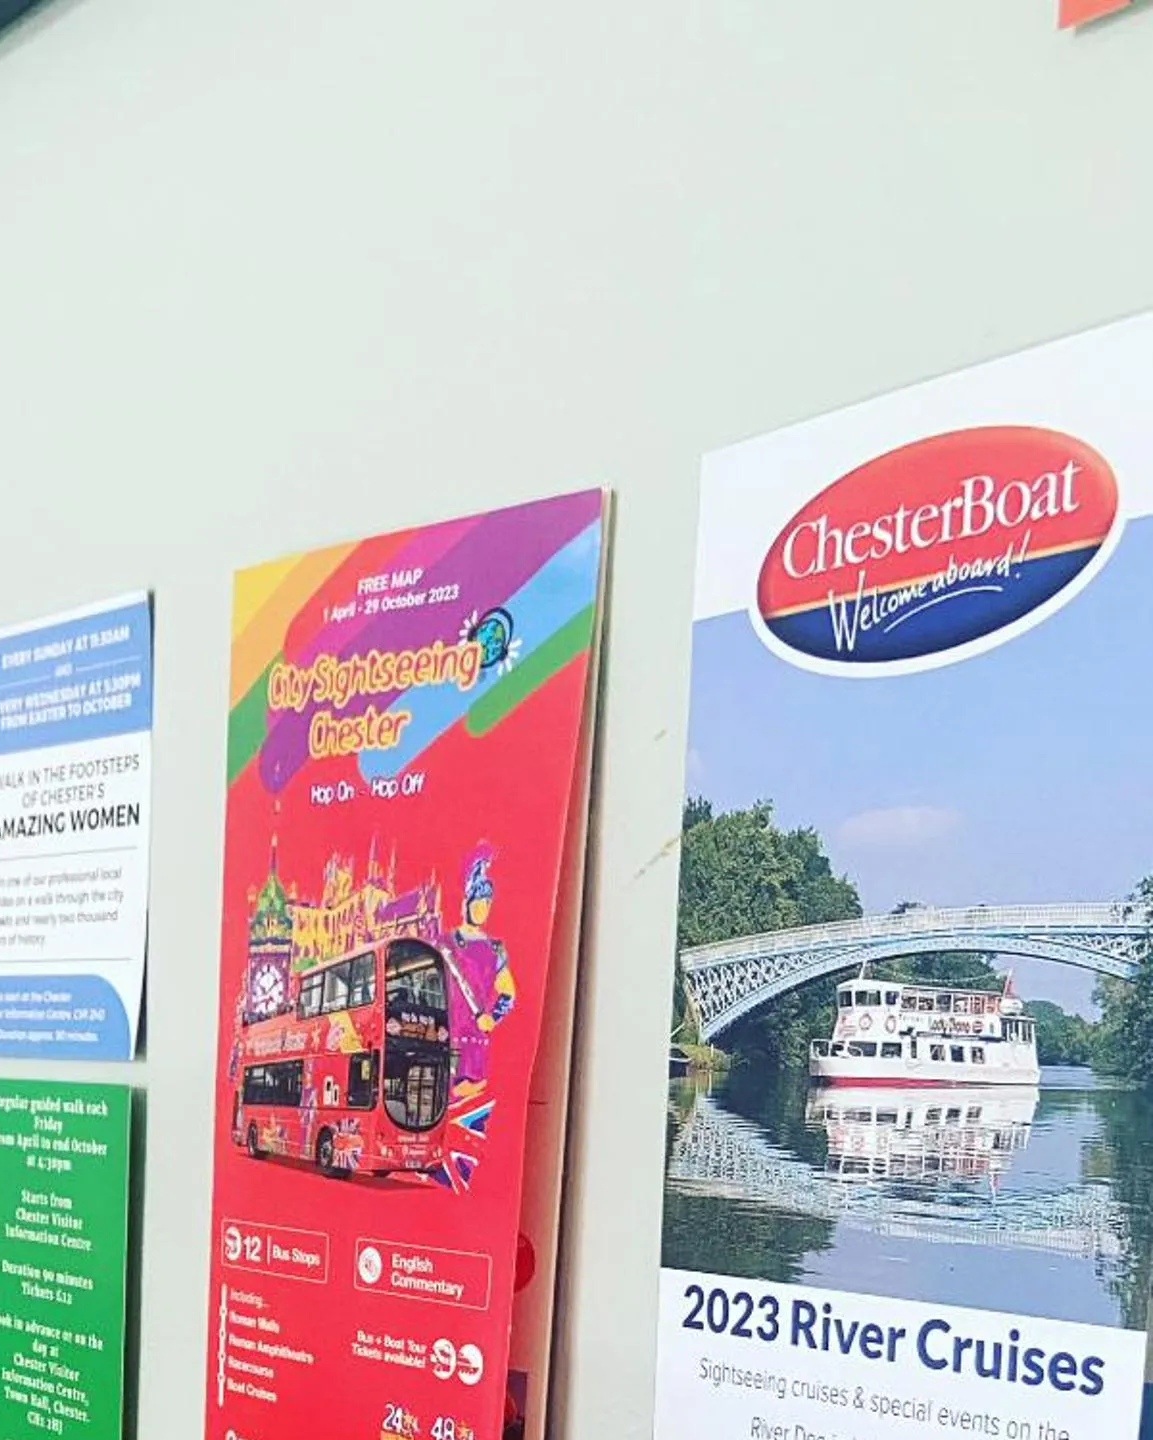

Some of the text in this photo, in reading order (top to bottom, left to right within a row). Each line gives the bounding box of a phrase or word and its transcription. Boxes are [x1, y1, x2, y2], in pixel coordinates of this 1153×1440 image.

[783, 459, 1084, 579] ChesterBoat
[357, 567, 424, 595] FREE MAP
[828, 529, 1032, 652] Welcome aboard!
[330, 601, 356, 623] April
[364, 598, 379, 615] 29
[381, 591, 426, 612] October
[428, 583, 460, 604] 2023
[311, 638, 482, 708] Sightseeing
[309, 707, 412, 760] Chester
[28, 769, 40, 784] IN
[43, 765, 66, 784] THE
[69, 754, 140, 780] FOOTSTEPS
[22, 790, 39, 808] OF
[310, 772, 425, 804] Hop On Hop Off
[70, 802, 140, 832] WOMEN
[30, 1096, 61, 1114] guided
[63, 1098, 84, 1114] walk
[86, 1100, 108, 1116] each
[34, 1116, 63, 1134] Friday
[17, 1132, 40, 1151] April
[71, 1137, 108, 1155] October
[21, 1189, 73, 1209] Starts from
[15, 1207, 83, 1230] Chester Visitor
[5, 1223, 59, 1246] Information
[243, 1234, 321, 1269] 12 Bus Stops
[391, 1253, 434, 1274] English
[1, 1259, 41, 1279] Duration
[55, 1271, 94, 1290] minutes
[391, 1271, 464, 1301] Commentary
[25, 1320, 61, 1340] advance
[682, 1283, 1106, 1397] 2023 River Cruises
[699, 1357, 786, 1400] Sightseeing
[791, 1378, 848, 1409] cruises
[852, 1386, 867, 1410] &
[870, 1391, 933, 1423] special
[938, 1405, 1001, 1437] events
